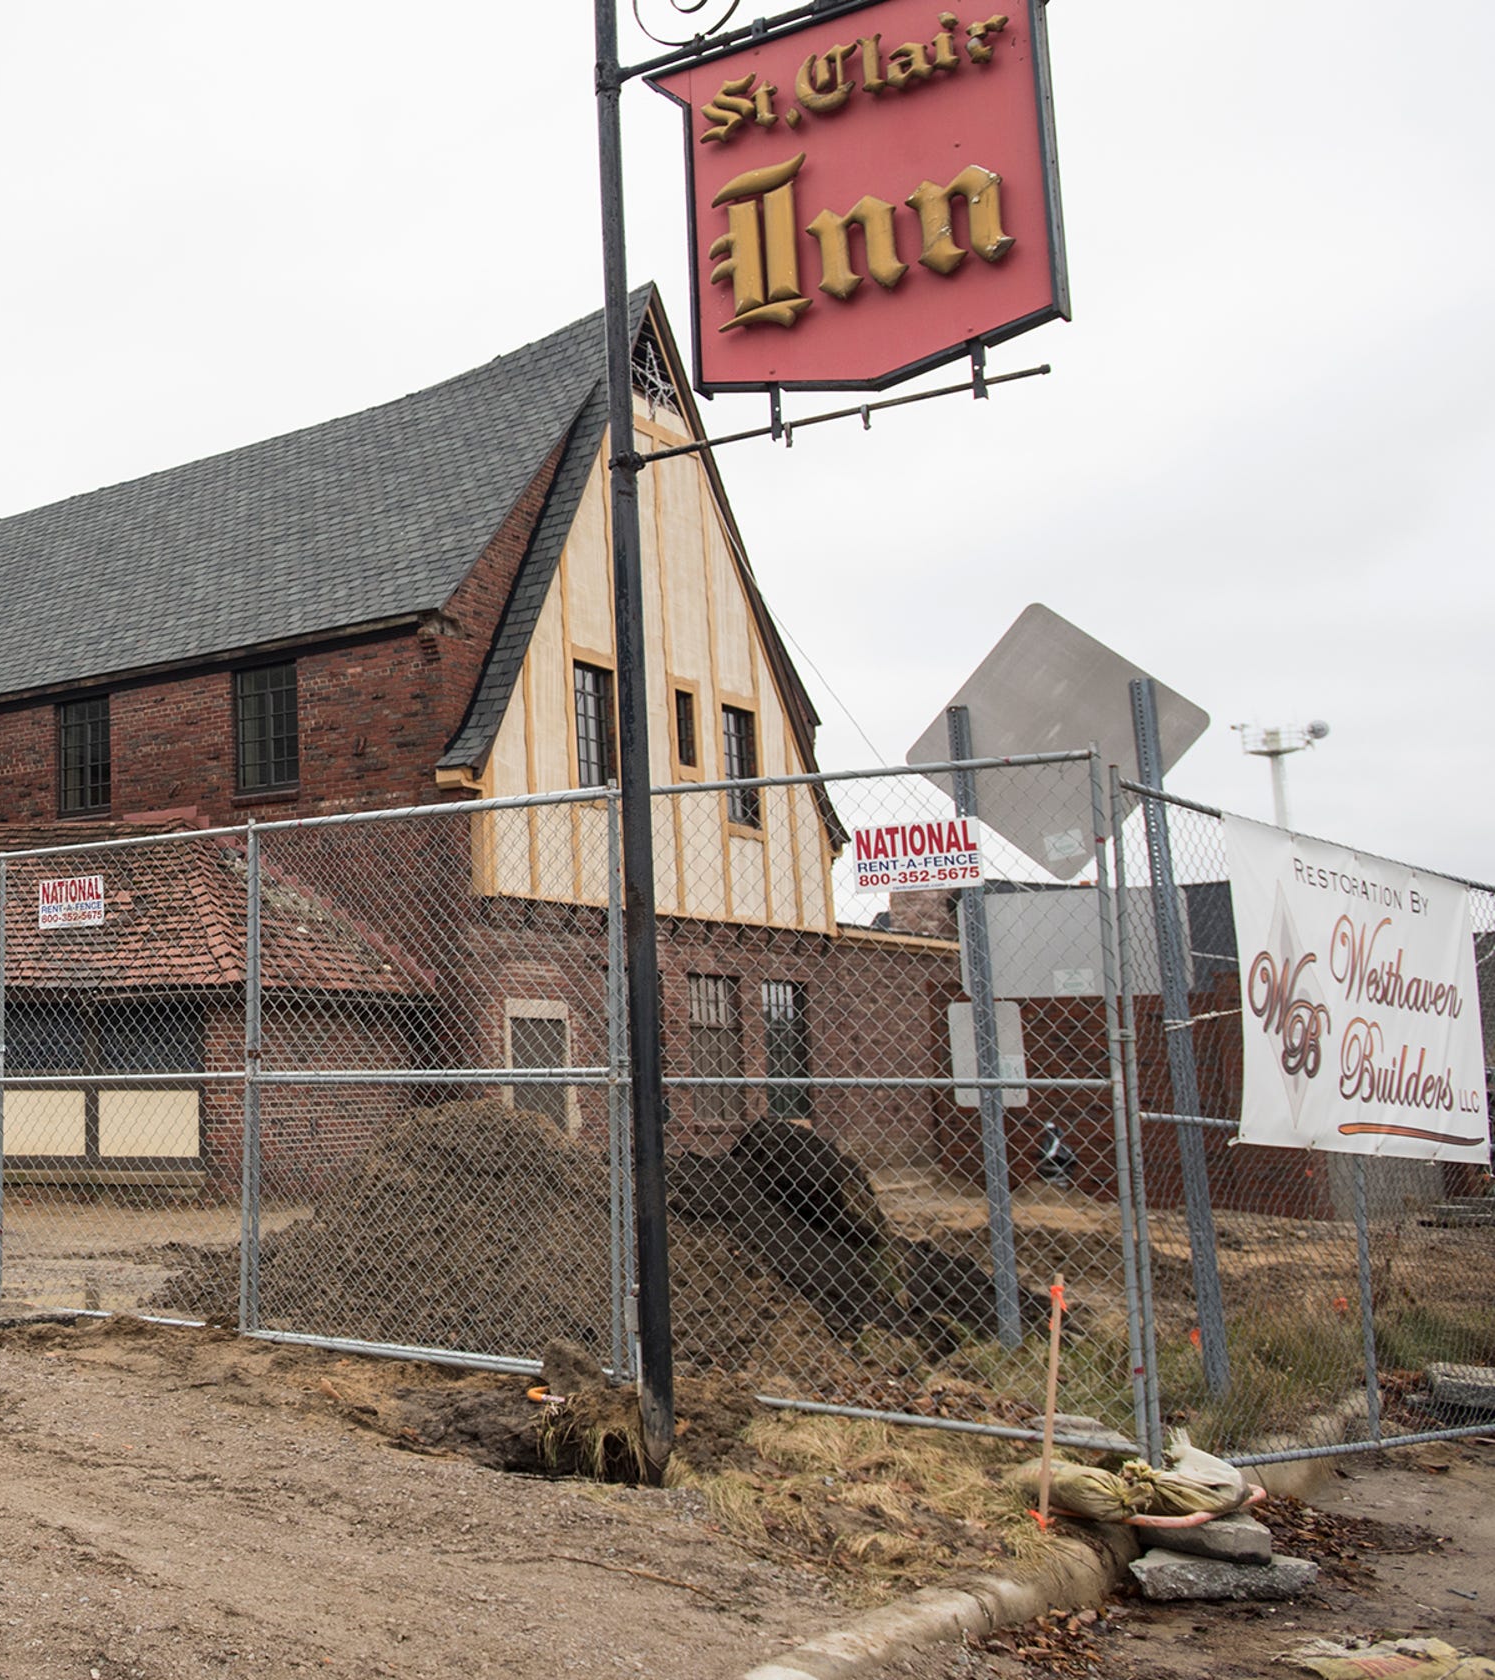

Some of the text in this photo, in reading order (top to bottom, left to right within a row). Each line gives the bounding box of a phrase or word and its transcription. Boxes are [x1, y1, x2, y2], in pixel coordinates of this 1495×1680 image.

[795, 12, 1008, 112] Clair
[709, 152, 1016, 333] Inn
[855, 820, 977, 860] NATIONAL
[857, 853, 979, 873] RENT-A-FENCE
[41, 877, 101, 904] NATIONAL
[859, 866, 980, 887] 800-352-5675
[1293, 858, 1402, 910] RESTORATION
[41, 901, 102, 913] RENT-A-FENCE
[1330, 914, 1462, 1018] Westhaven
[1340, 1017, 1479, 1112] Builders LLC
